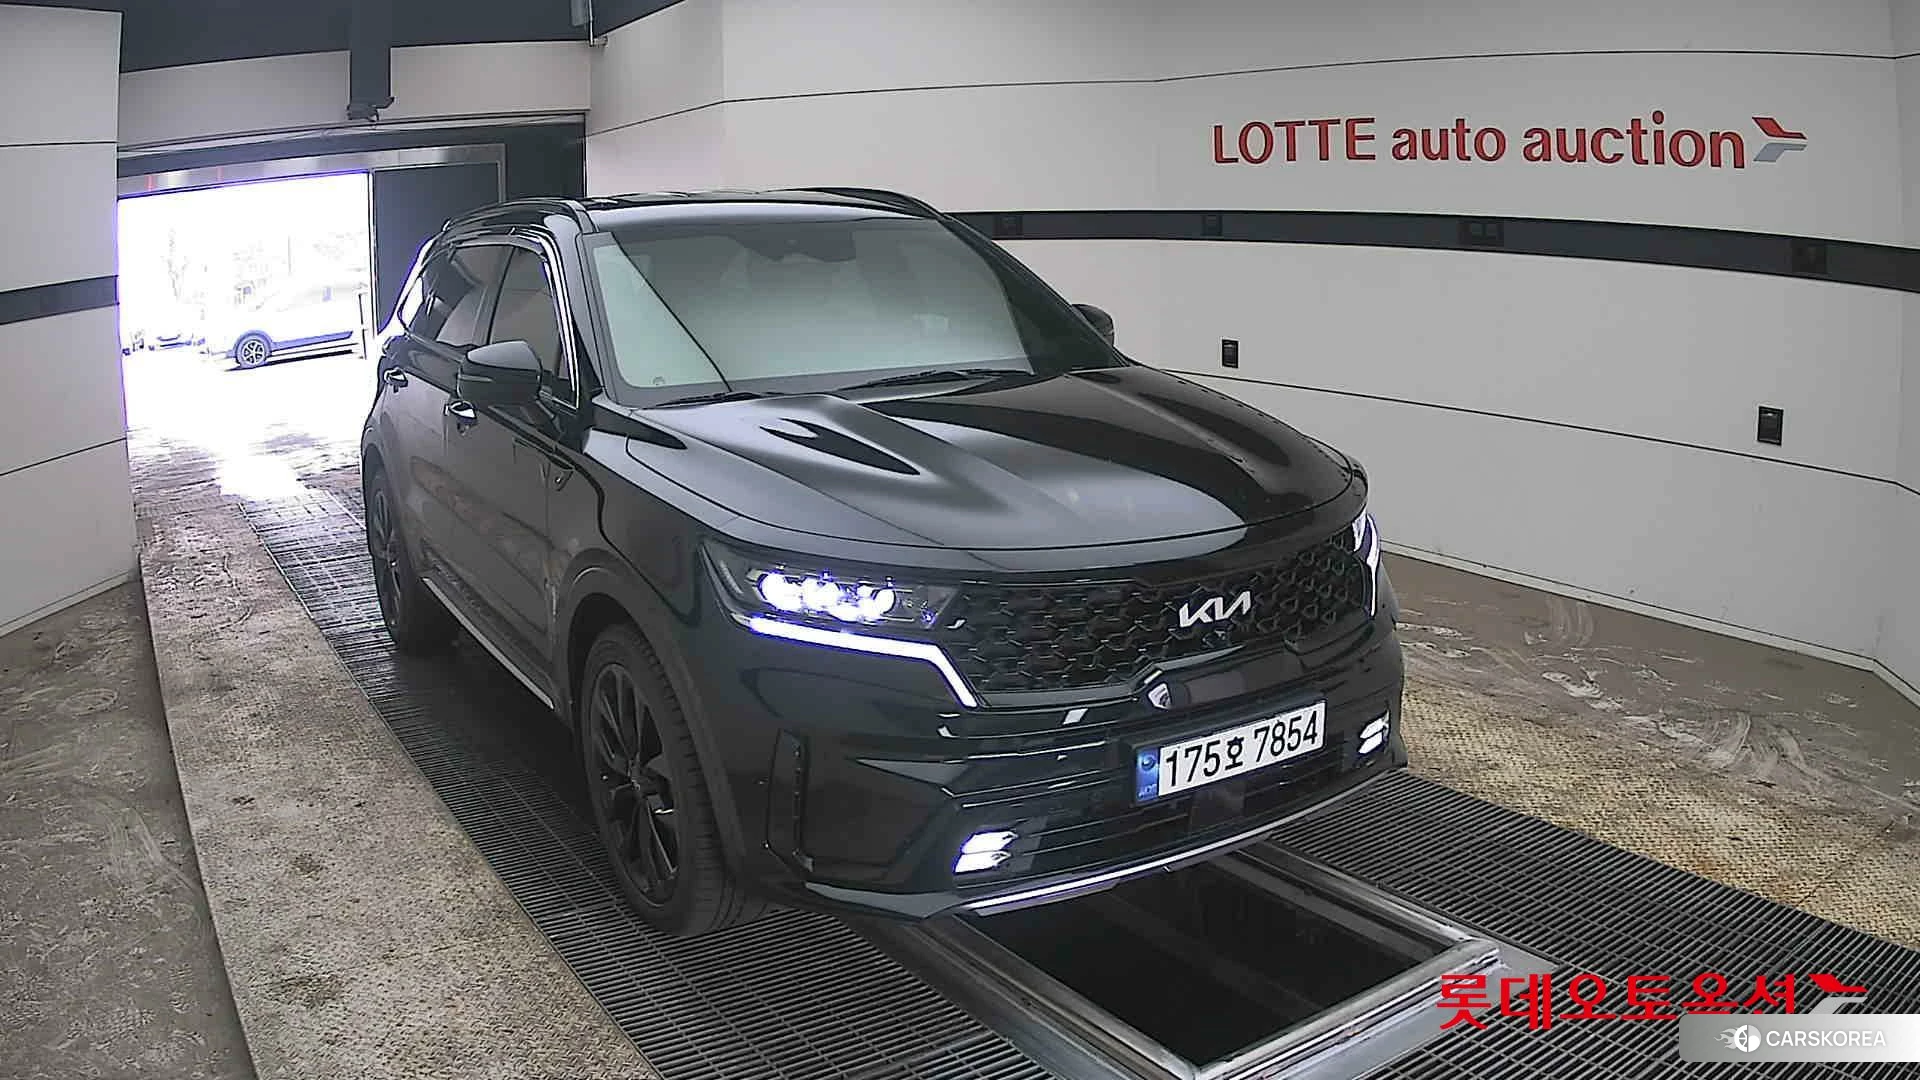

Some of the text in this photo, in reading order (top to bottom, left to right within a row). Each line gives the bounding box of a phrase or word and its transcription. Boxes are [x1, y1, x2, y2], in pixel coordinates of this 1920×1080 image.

[1212, 110, 1746, 169] LOTTE auto auction
[1165, 710, 1318, 787] 175호 7854
